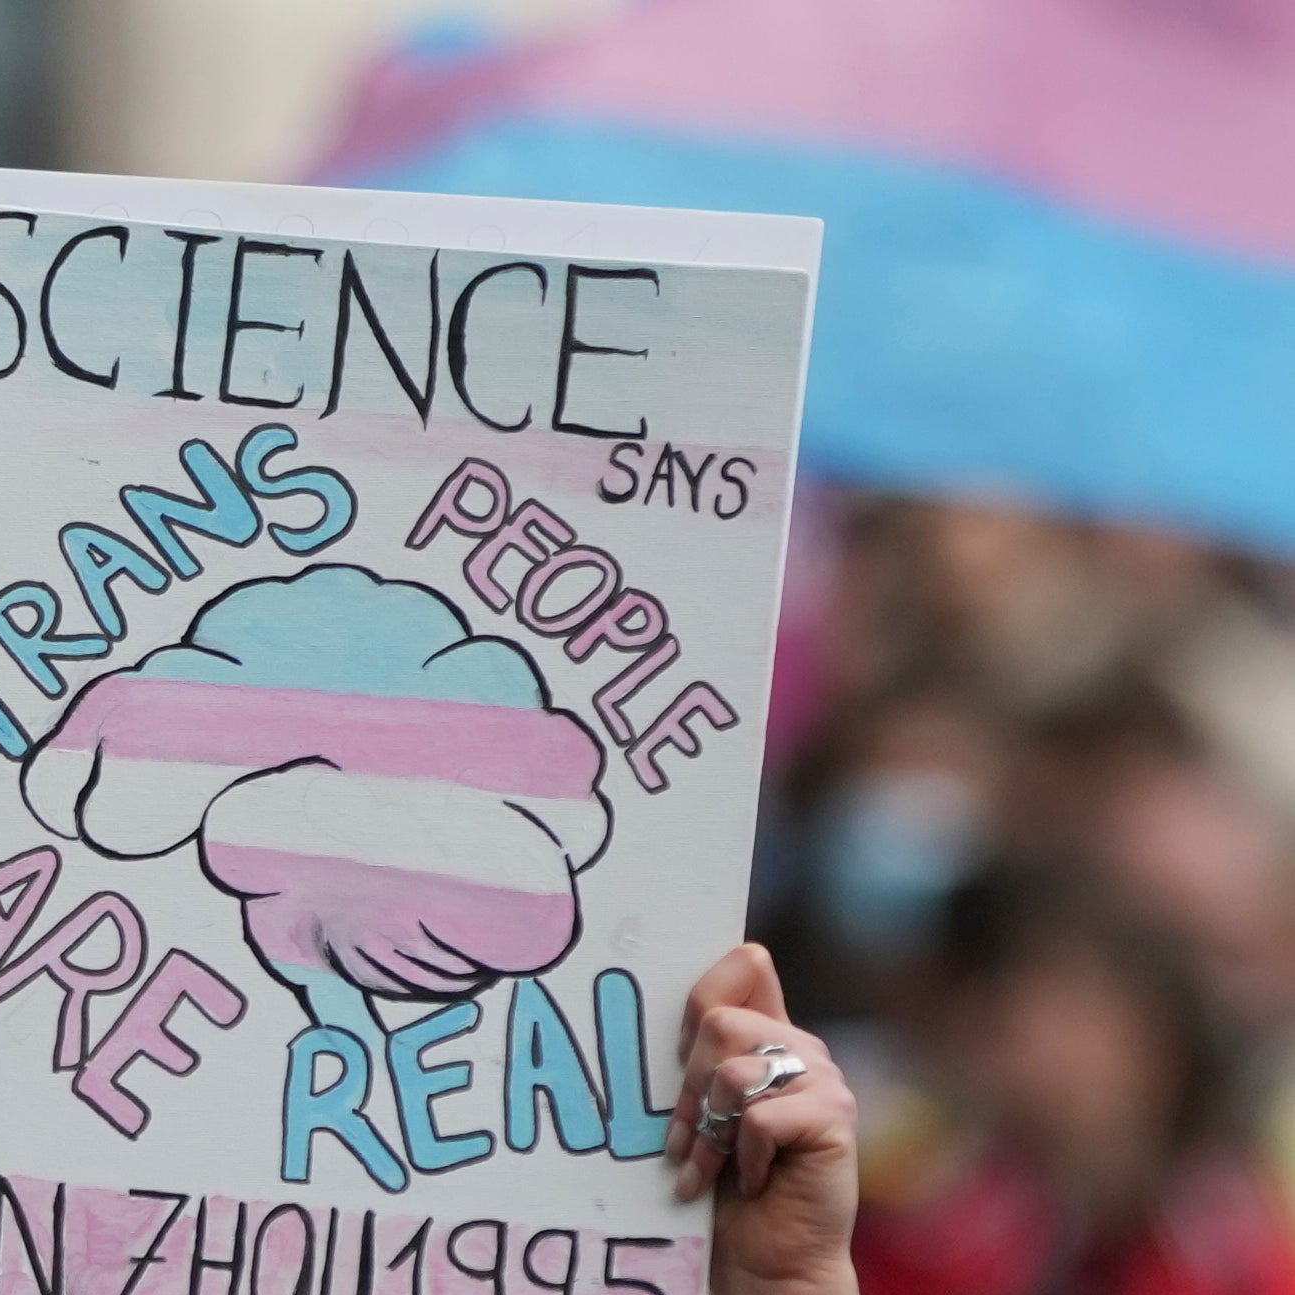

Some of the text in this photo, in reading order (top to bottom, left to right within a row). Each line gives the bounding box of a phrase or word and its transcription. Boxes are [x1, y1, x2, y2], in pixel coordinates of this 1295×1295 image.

[595, 440, 759, 521] SAYS
[405, 455, 741, 795] PEOPLE
[279, 966, 673, 1194] REAL
